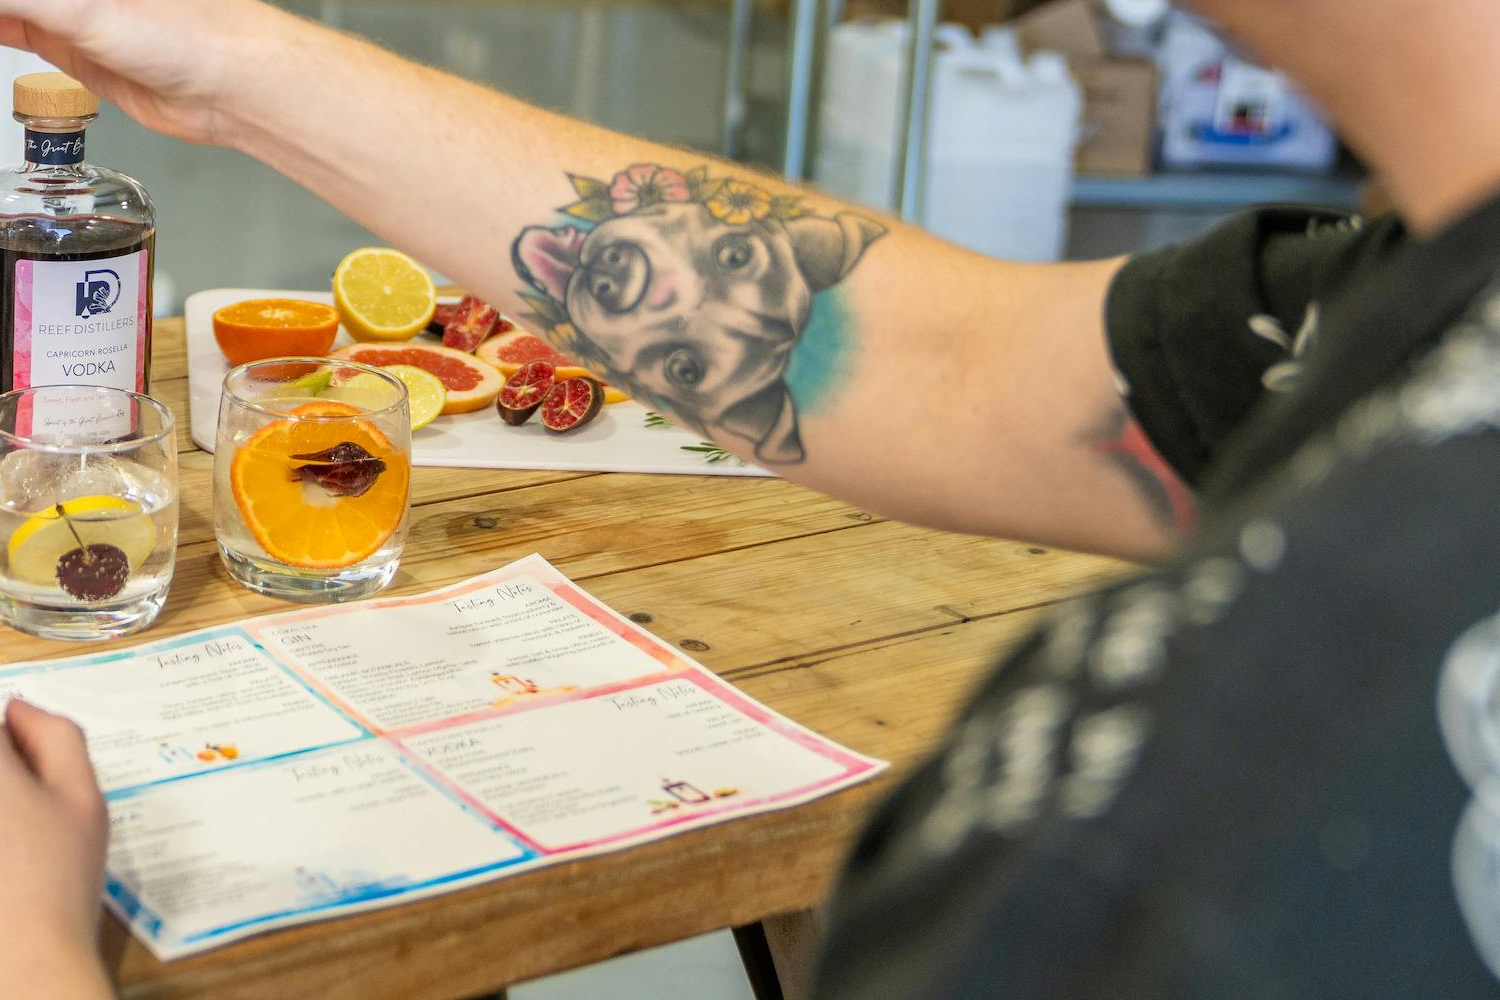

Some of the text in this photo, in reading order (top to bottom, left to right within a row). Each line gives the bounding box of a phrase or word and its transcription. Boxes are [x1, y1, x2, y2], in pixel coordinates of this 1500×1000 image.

[41, 140, 74, 157] Great
[39, 315, 134, 335] REEF DISTILLERS
[46, 343, 128, 359] CAPRICORN ROSELLA
[62, 360, 116, 377] VODKA
[280, 632, 312, 646] GIN
